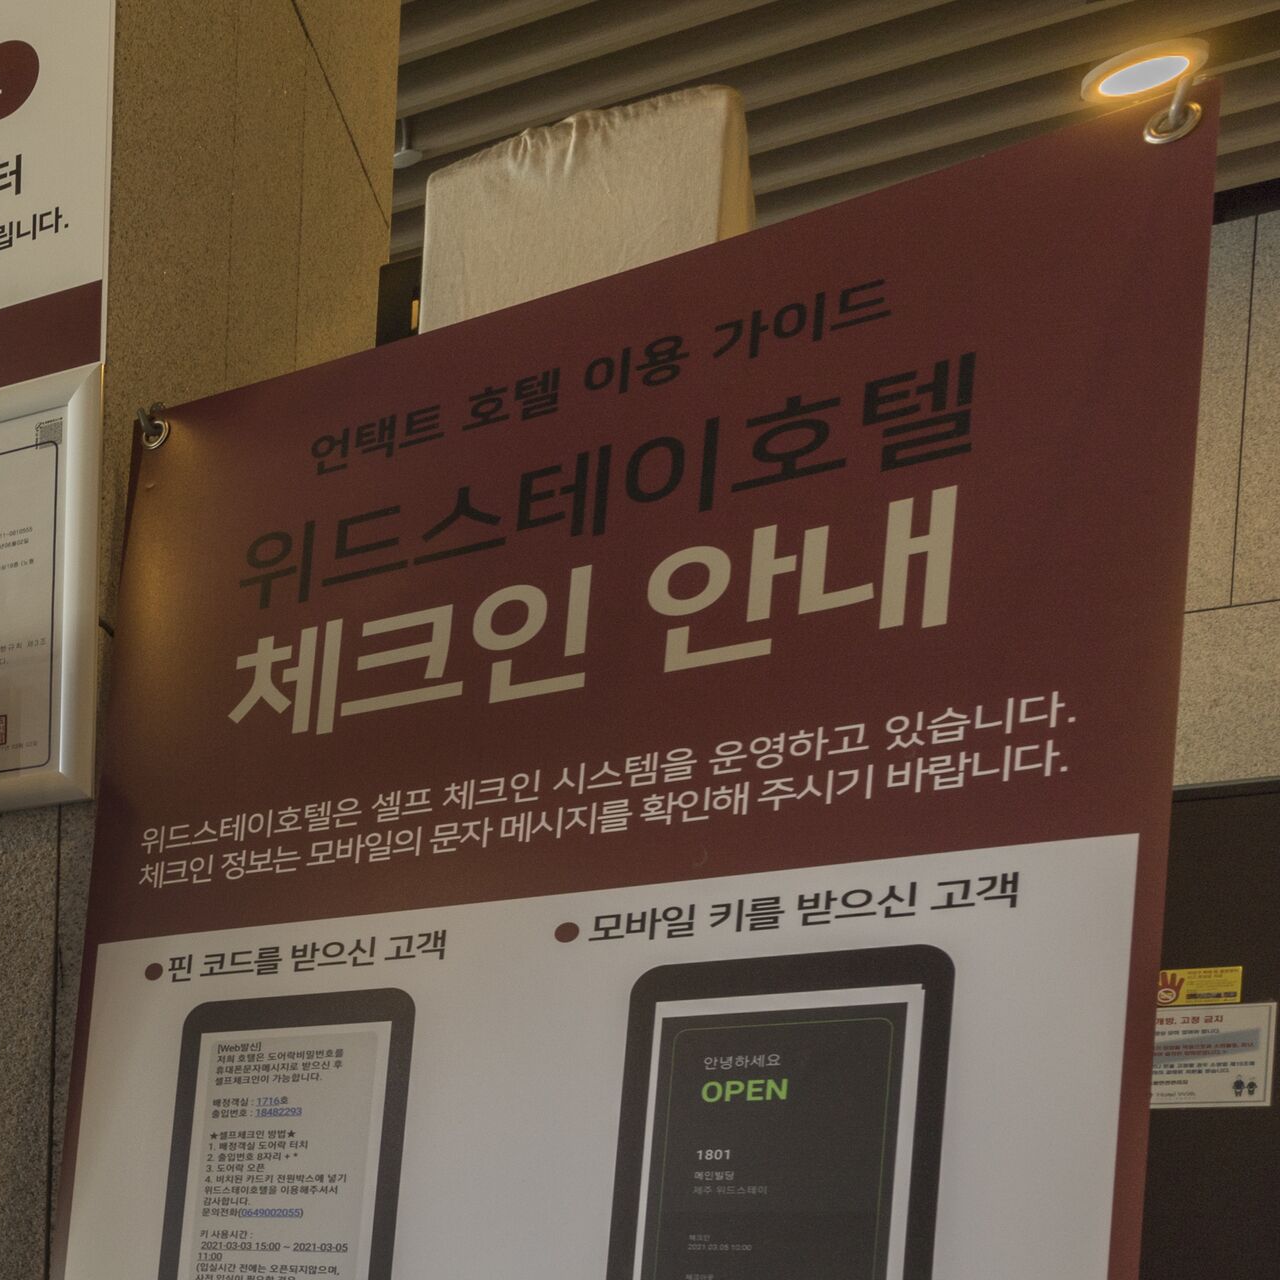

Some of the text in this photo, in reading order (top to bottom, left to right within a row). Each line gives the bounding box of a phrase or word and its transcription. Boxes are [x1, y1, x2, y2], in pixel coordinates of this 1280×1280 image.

[308, 277, 892, 477] 언택트 호텔 이용 가이드
[239, 353, 978, 612] 위드스테이호텔
[226, 484, 958, 734] 체크인 안내
[139, 739, 1069, 889] 체크인 정보는 모바일의 문자 메시지를 확인해 주시기 바랍니다.
[141, 690, 1077, 854] 위드스테이호텔은 셀프 체크인 시스템을 운영하고 있습니다.
[168, 930, 447, 983] 핀 코드를 받으신 고객
[588, 872, 1020, 942] 모바일 키를 받으신 고객
[701, 1079, 788, 1103] OPEN
[703, 1053, 781, 1071] 안녕하세요
[696, 1148, 732, 1161] 1801
